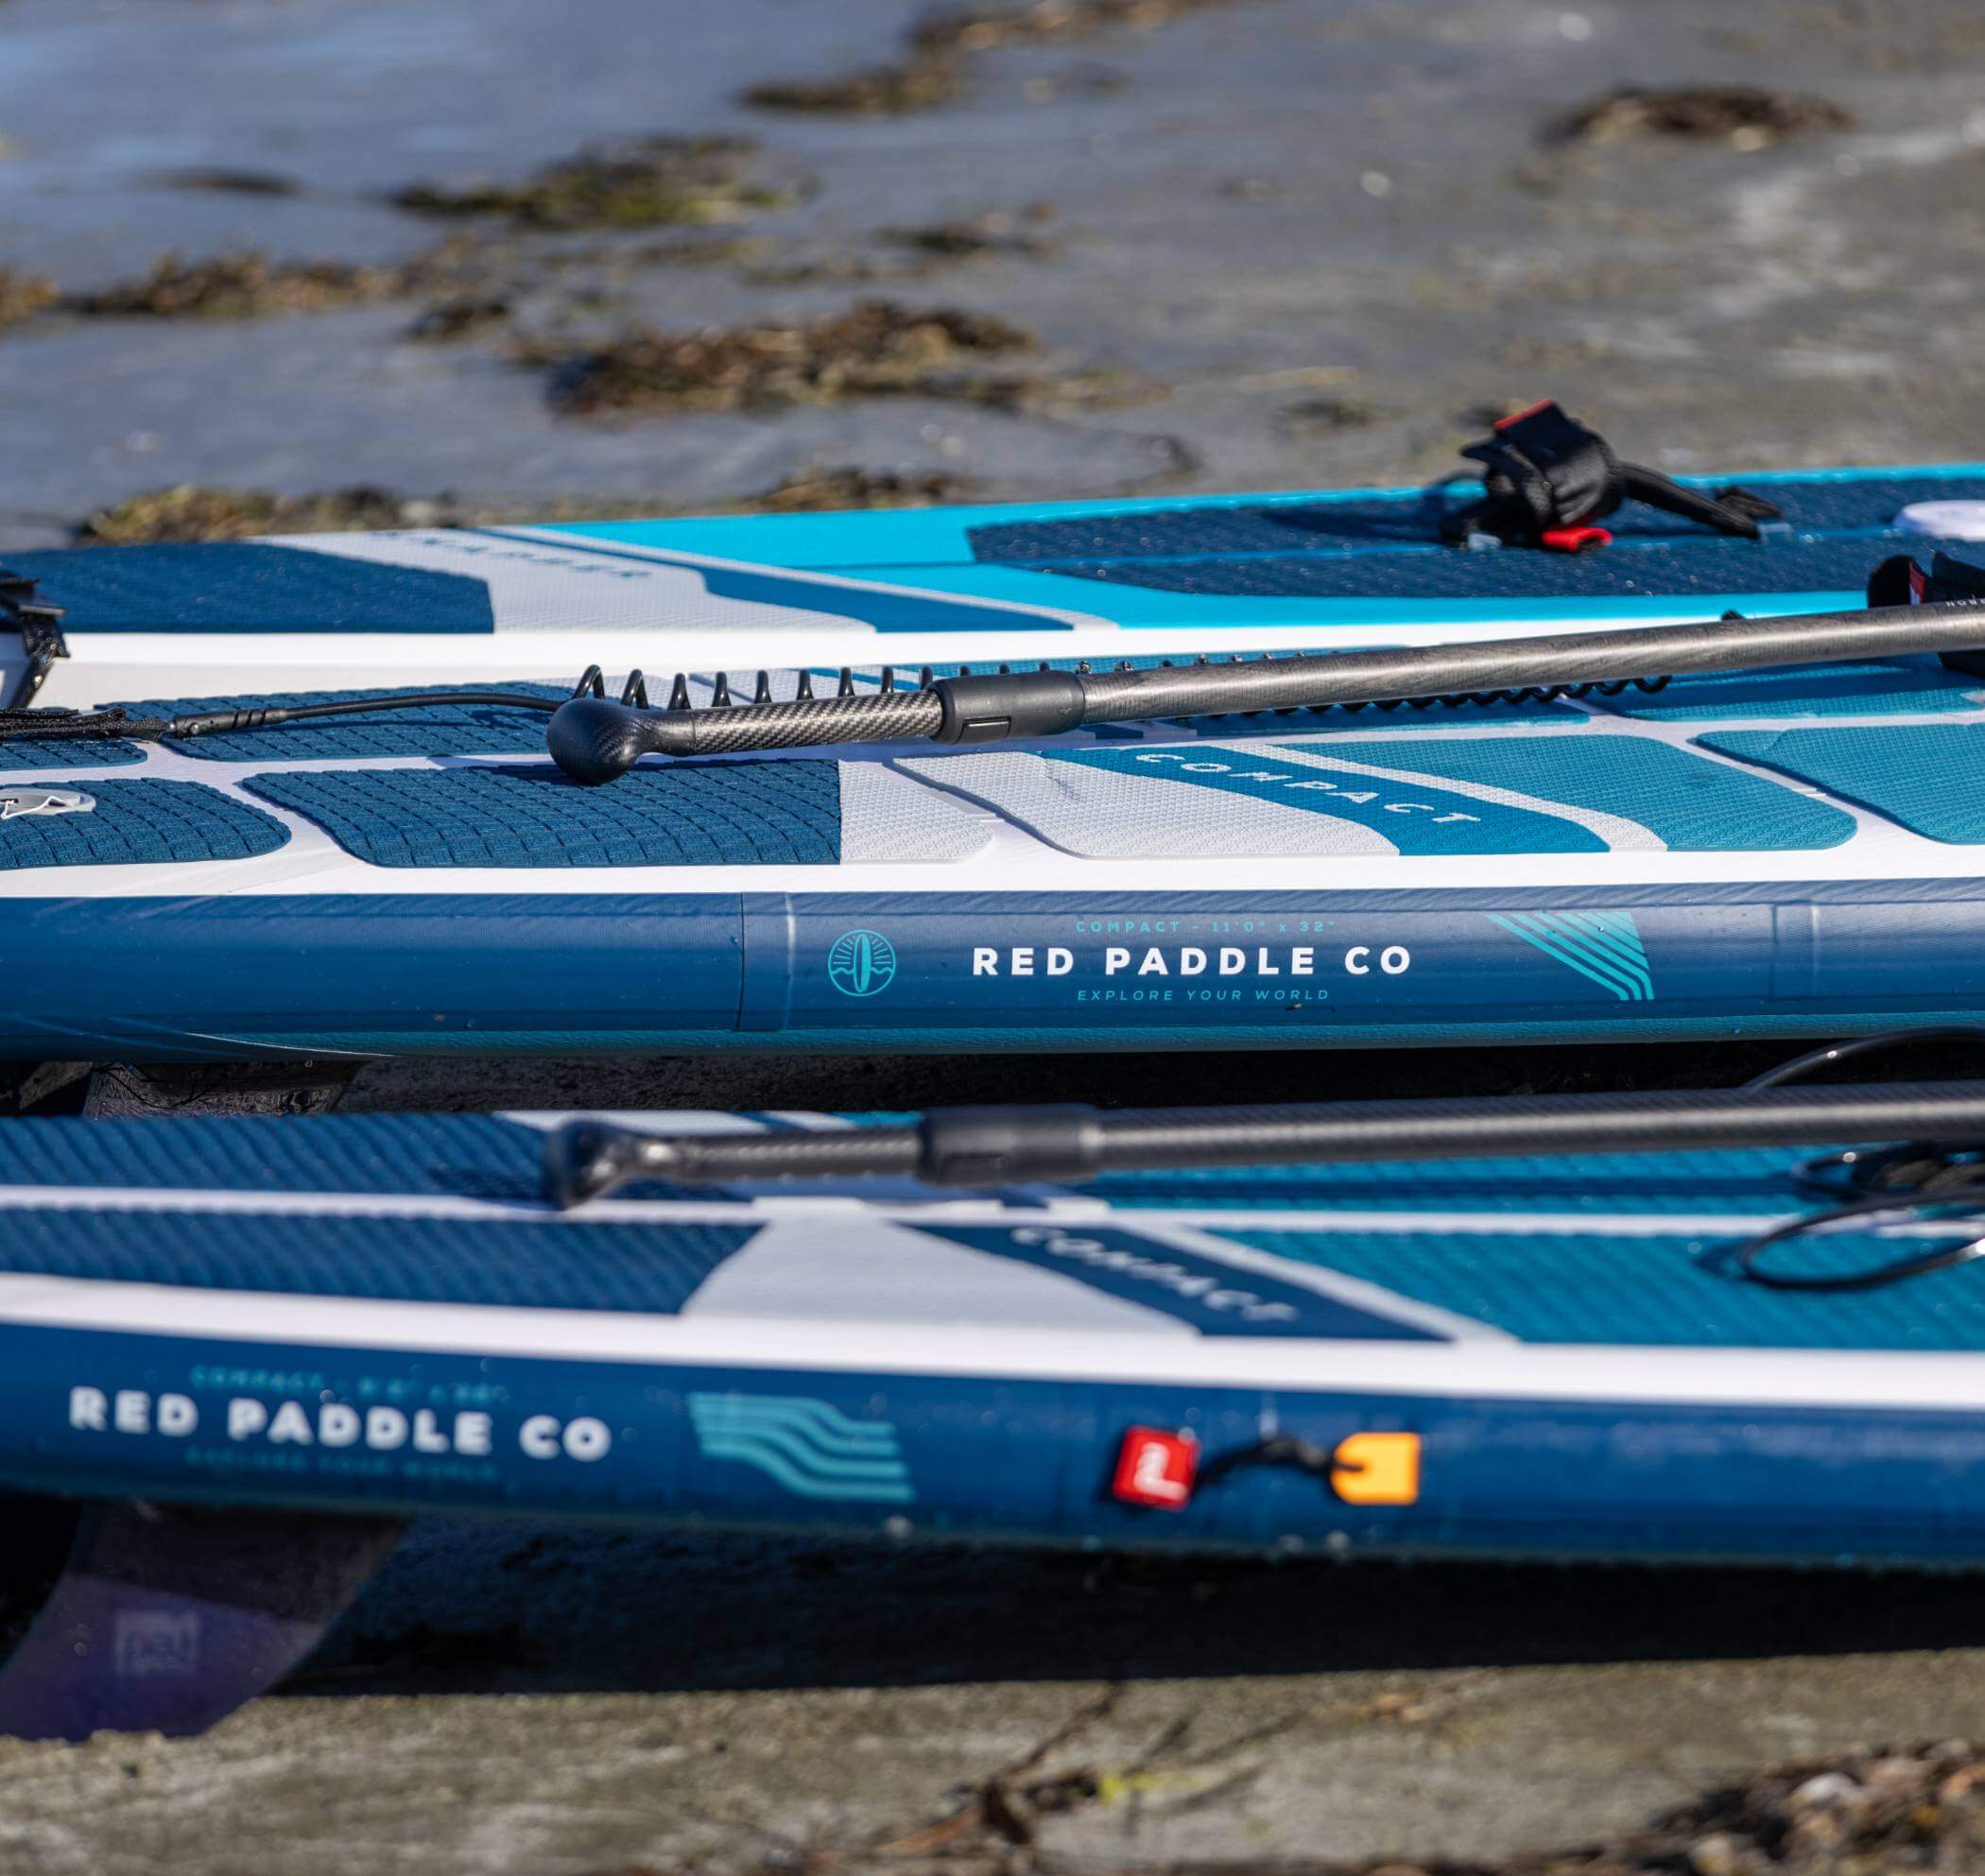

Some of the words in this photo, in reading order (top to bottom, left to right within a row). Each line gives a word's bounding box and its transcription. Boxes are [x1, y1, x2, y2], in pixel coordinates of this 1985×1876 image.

[1136, 753, 1481, 824] COMPACT
[1076, 921, 1180, 933] COMPACT
[972, 947, 1074, 975] RED
[1105, 946, 1314, 976] PADDLE
[1344, 946, 1412, 975] CO
[1077, 990, 1174, 1001] EXPLORE
[1186, 990, 1243, 1001] YOUR
[1255, 990, 1330, 1001] WORLD
[69, 1385, 198, 1437] RED
[227, 1397, 494, 1456] PADDLE
[518, 1415, 613, 1463] CO
